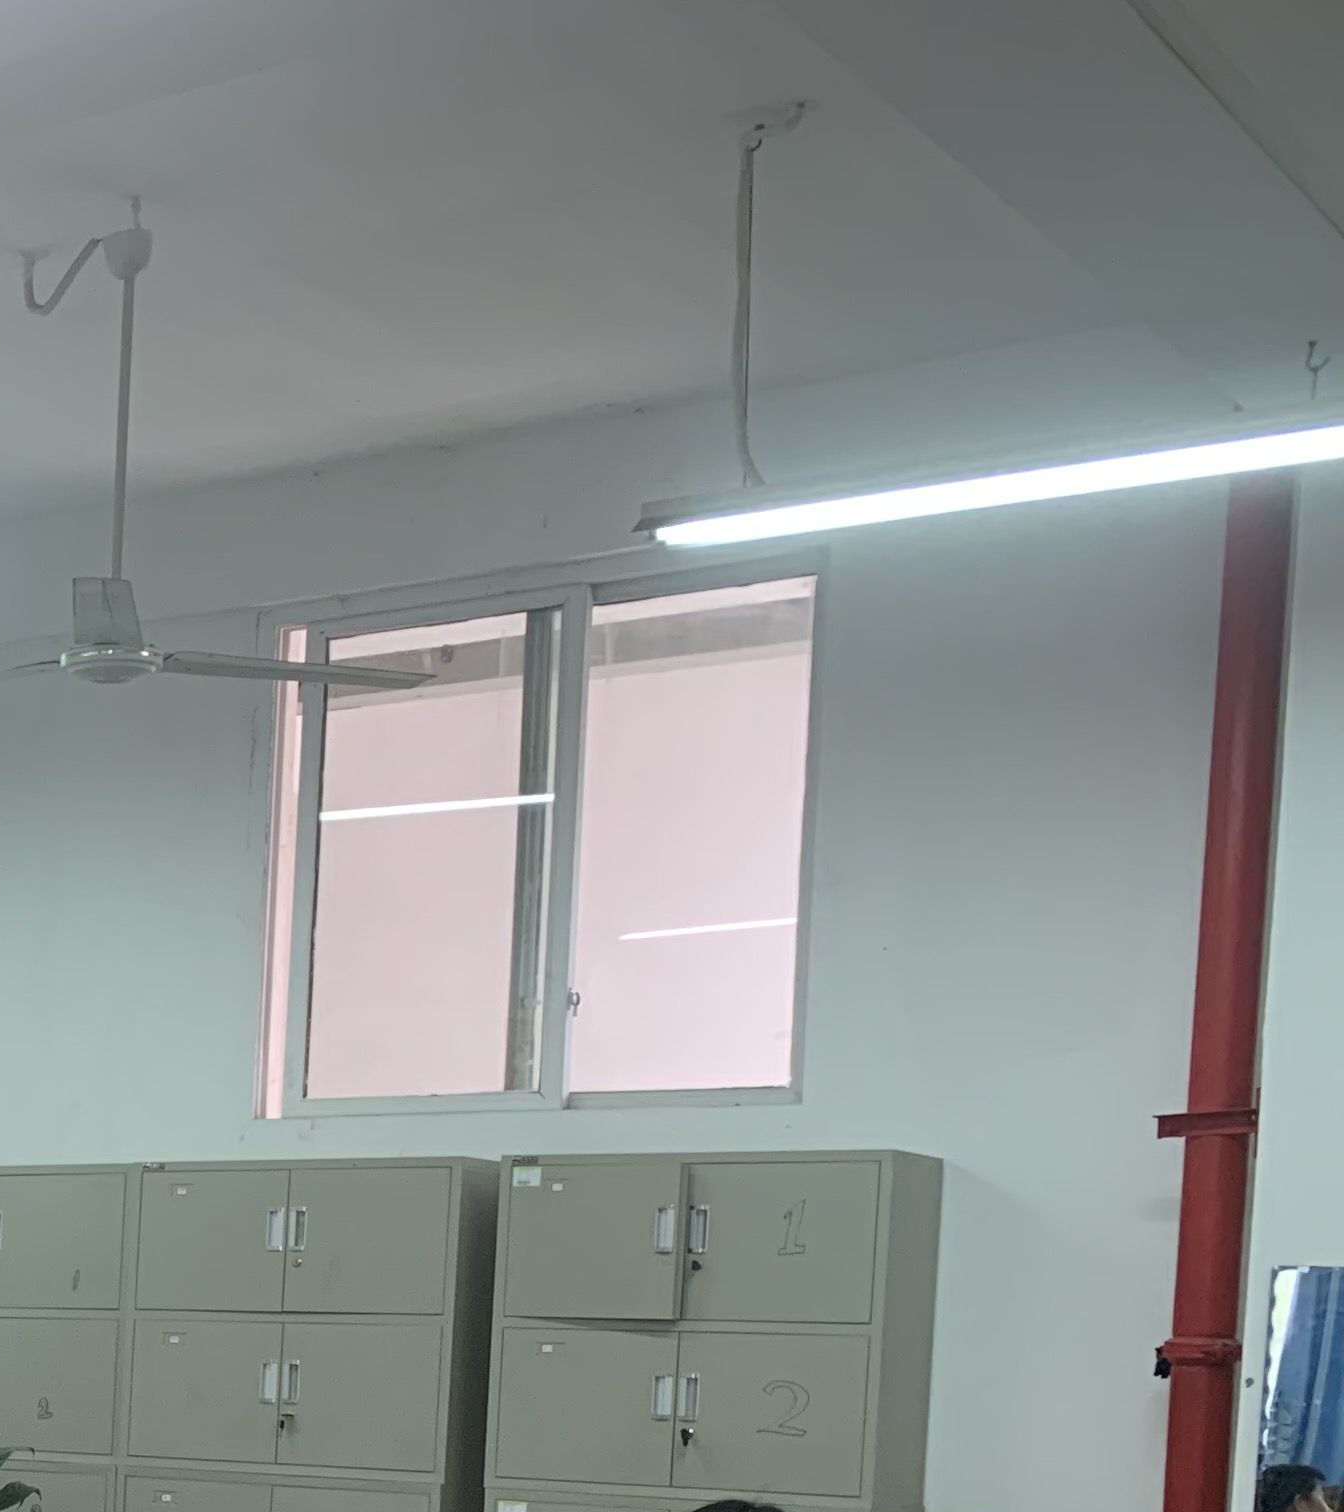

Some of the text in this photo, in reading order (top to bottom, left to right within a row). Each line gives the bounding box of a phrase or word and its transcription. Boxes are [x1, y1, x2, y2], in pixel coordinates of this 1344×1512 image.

[778, 1199, 807, 1257] 1
[37, 1396, 54, 1420] 2
[756, 1379, 811, 1438] 2
